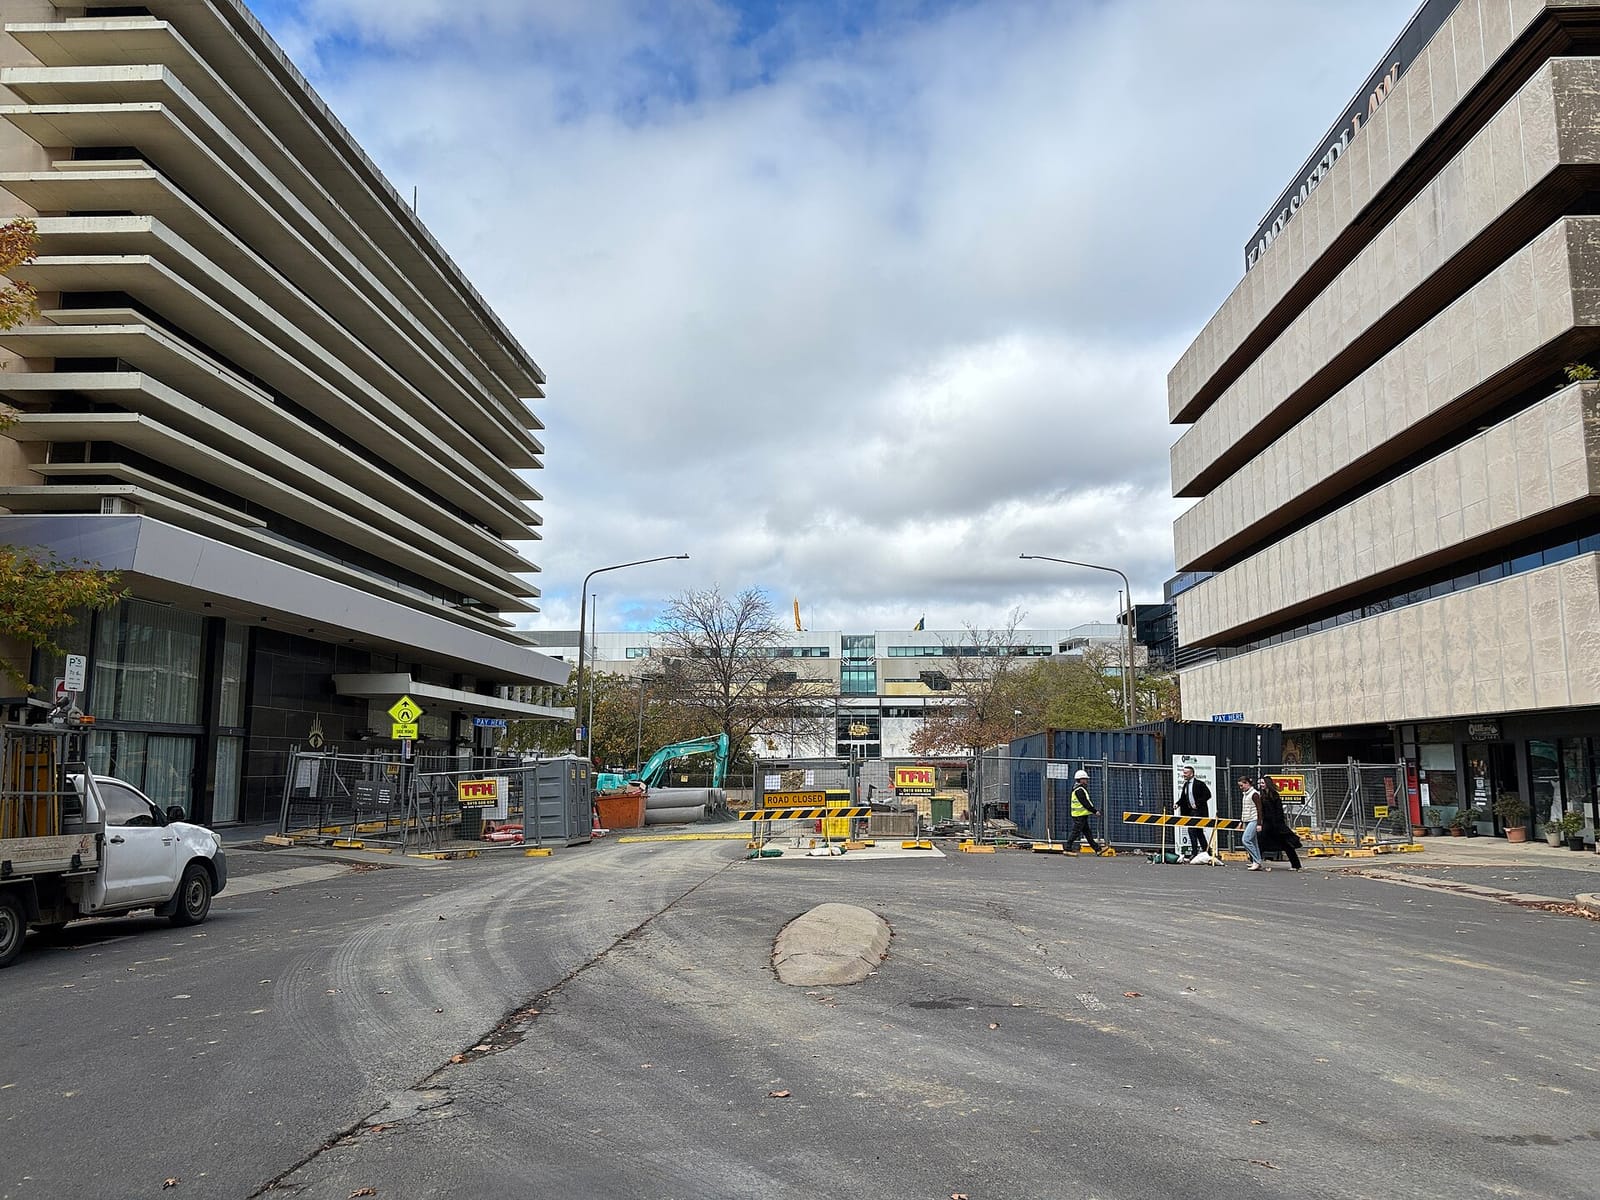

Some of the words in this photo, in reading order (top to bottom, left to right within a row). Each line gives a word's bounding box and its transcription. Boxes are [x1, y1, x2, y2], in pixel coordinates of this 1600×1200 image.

[476, 718, 489, 726] PAY
[1214, 714, 1226, 722] PAY
[1229, 712, 1244, 721] HERE
[899, 770, 929, 784] TFH
[461, 783, 493, 797] TFH
[767, 795, 789, 804] ROAD
[792, 794, 823, 803] CLOSED
